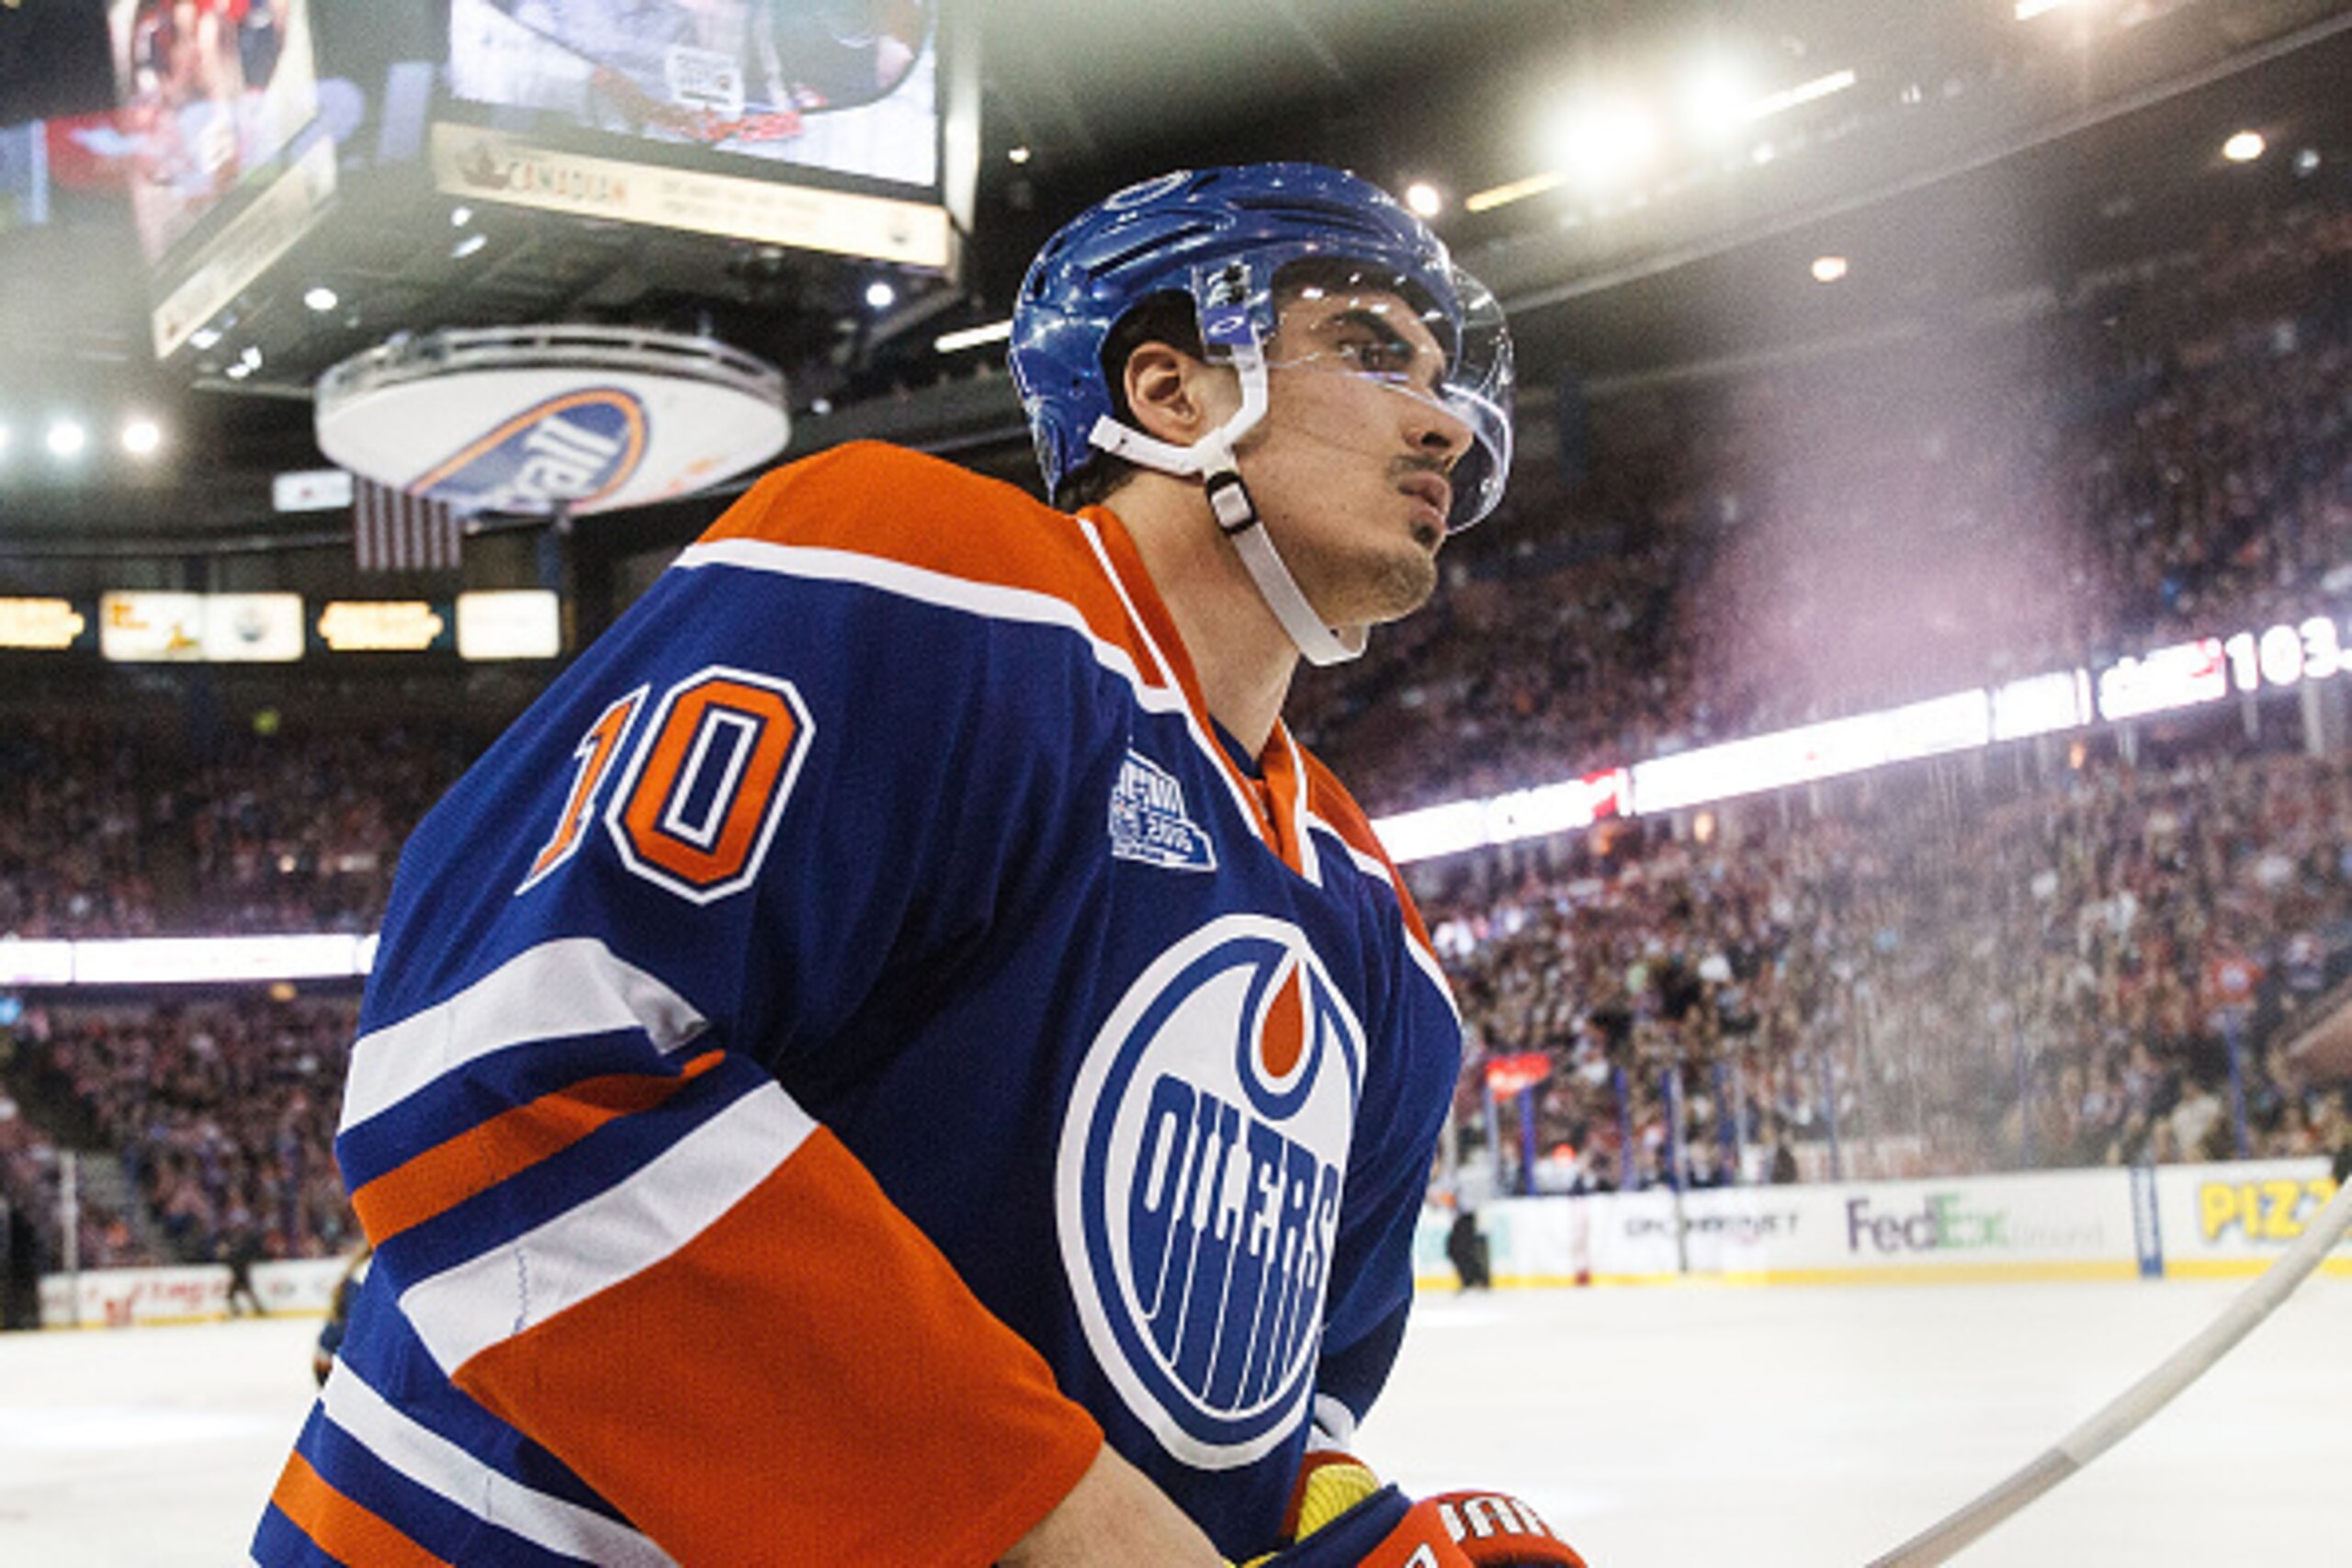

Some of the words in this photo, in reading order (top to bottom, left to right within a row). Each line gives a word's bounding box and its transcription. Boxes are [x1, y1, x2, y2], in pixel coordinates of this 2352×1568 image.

[514, 665, 816, 906] 10
[1128, 1073, 1340, 1413] OILERS
[1846, 1191, 2010, 1252] FedEx
